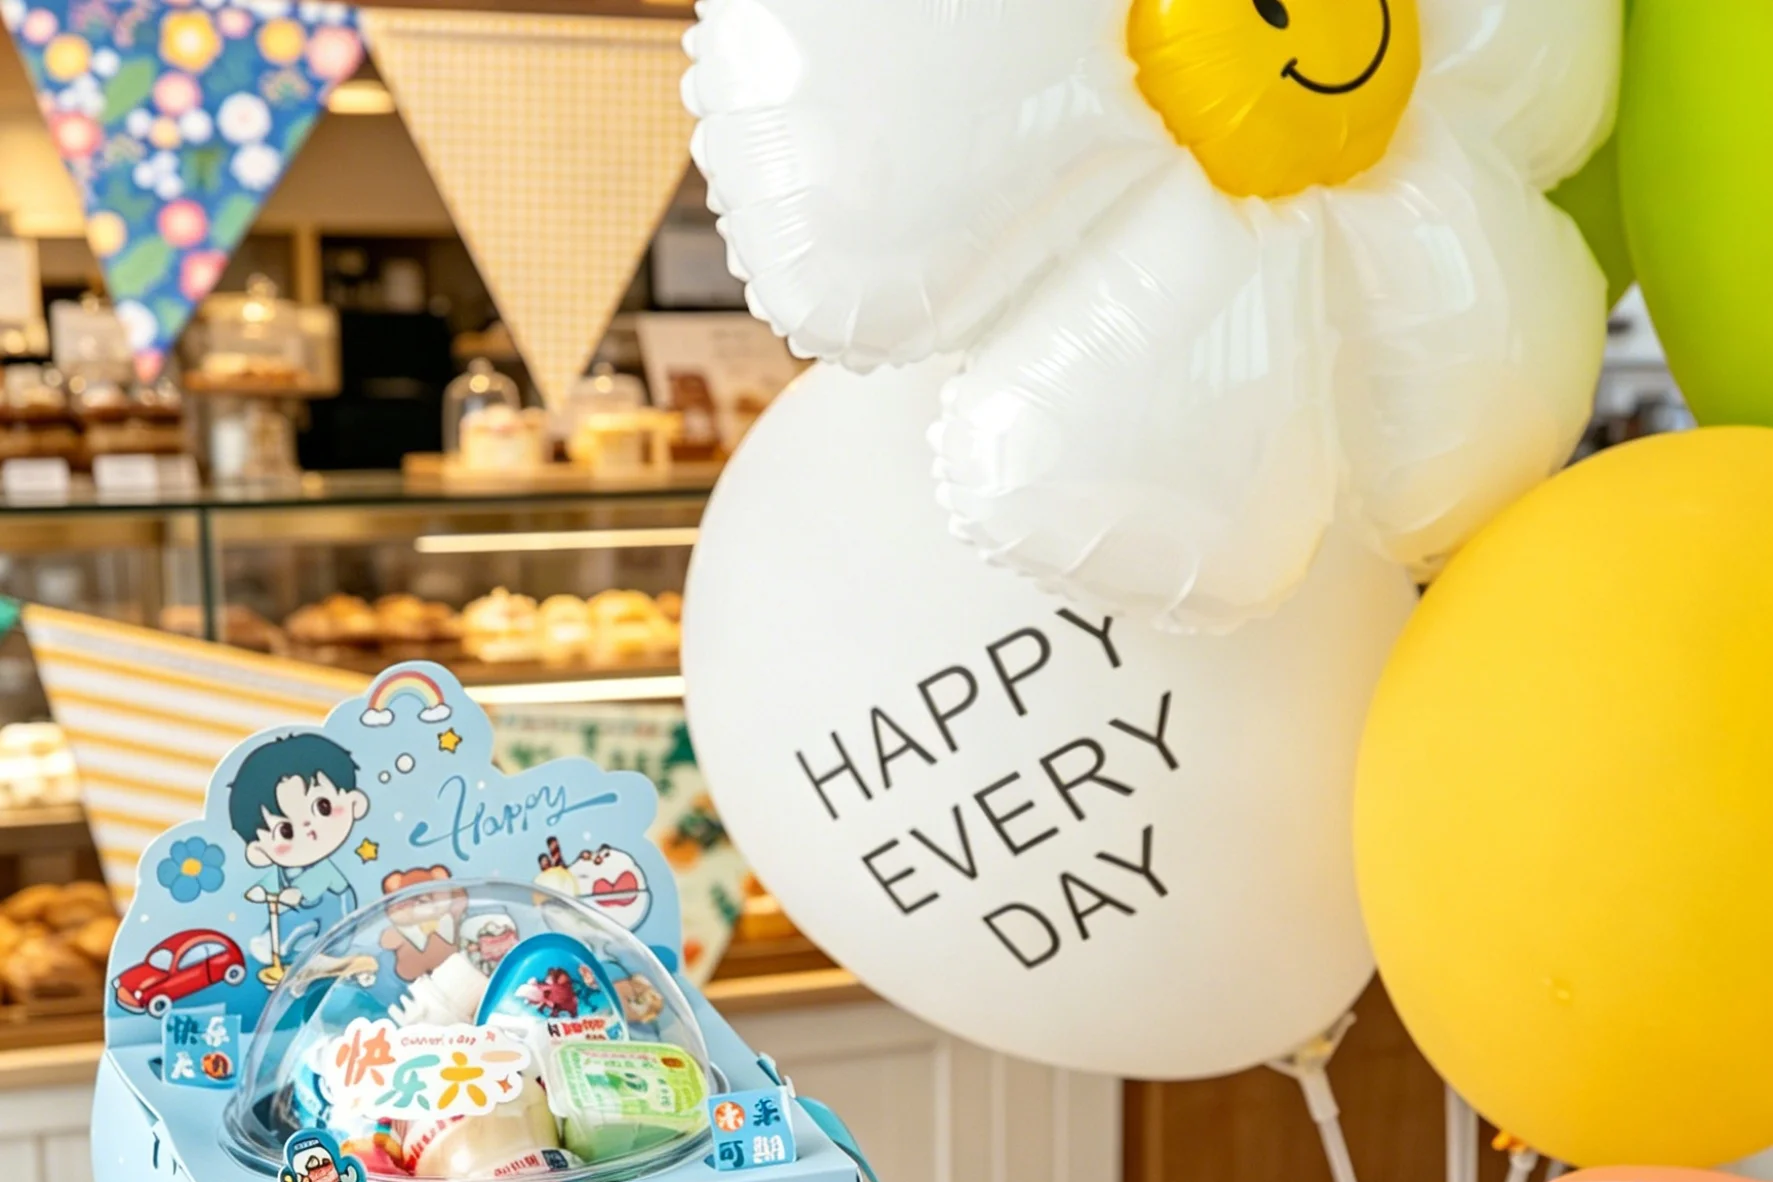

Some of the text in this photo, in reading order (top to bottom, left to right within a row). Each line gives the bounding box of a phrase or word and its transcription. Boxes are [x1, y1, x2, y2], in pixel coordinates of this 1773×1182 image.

[796, 606, 1122, 821] HAPPY
[408, 775, 618, 861] Happy
[861, 690, 1180, 916] EVERY
[982, 824, 1169, 970] DAY
[335, 1026, 523, 1111] 快乐六一
